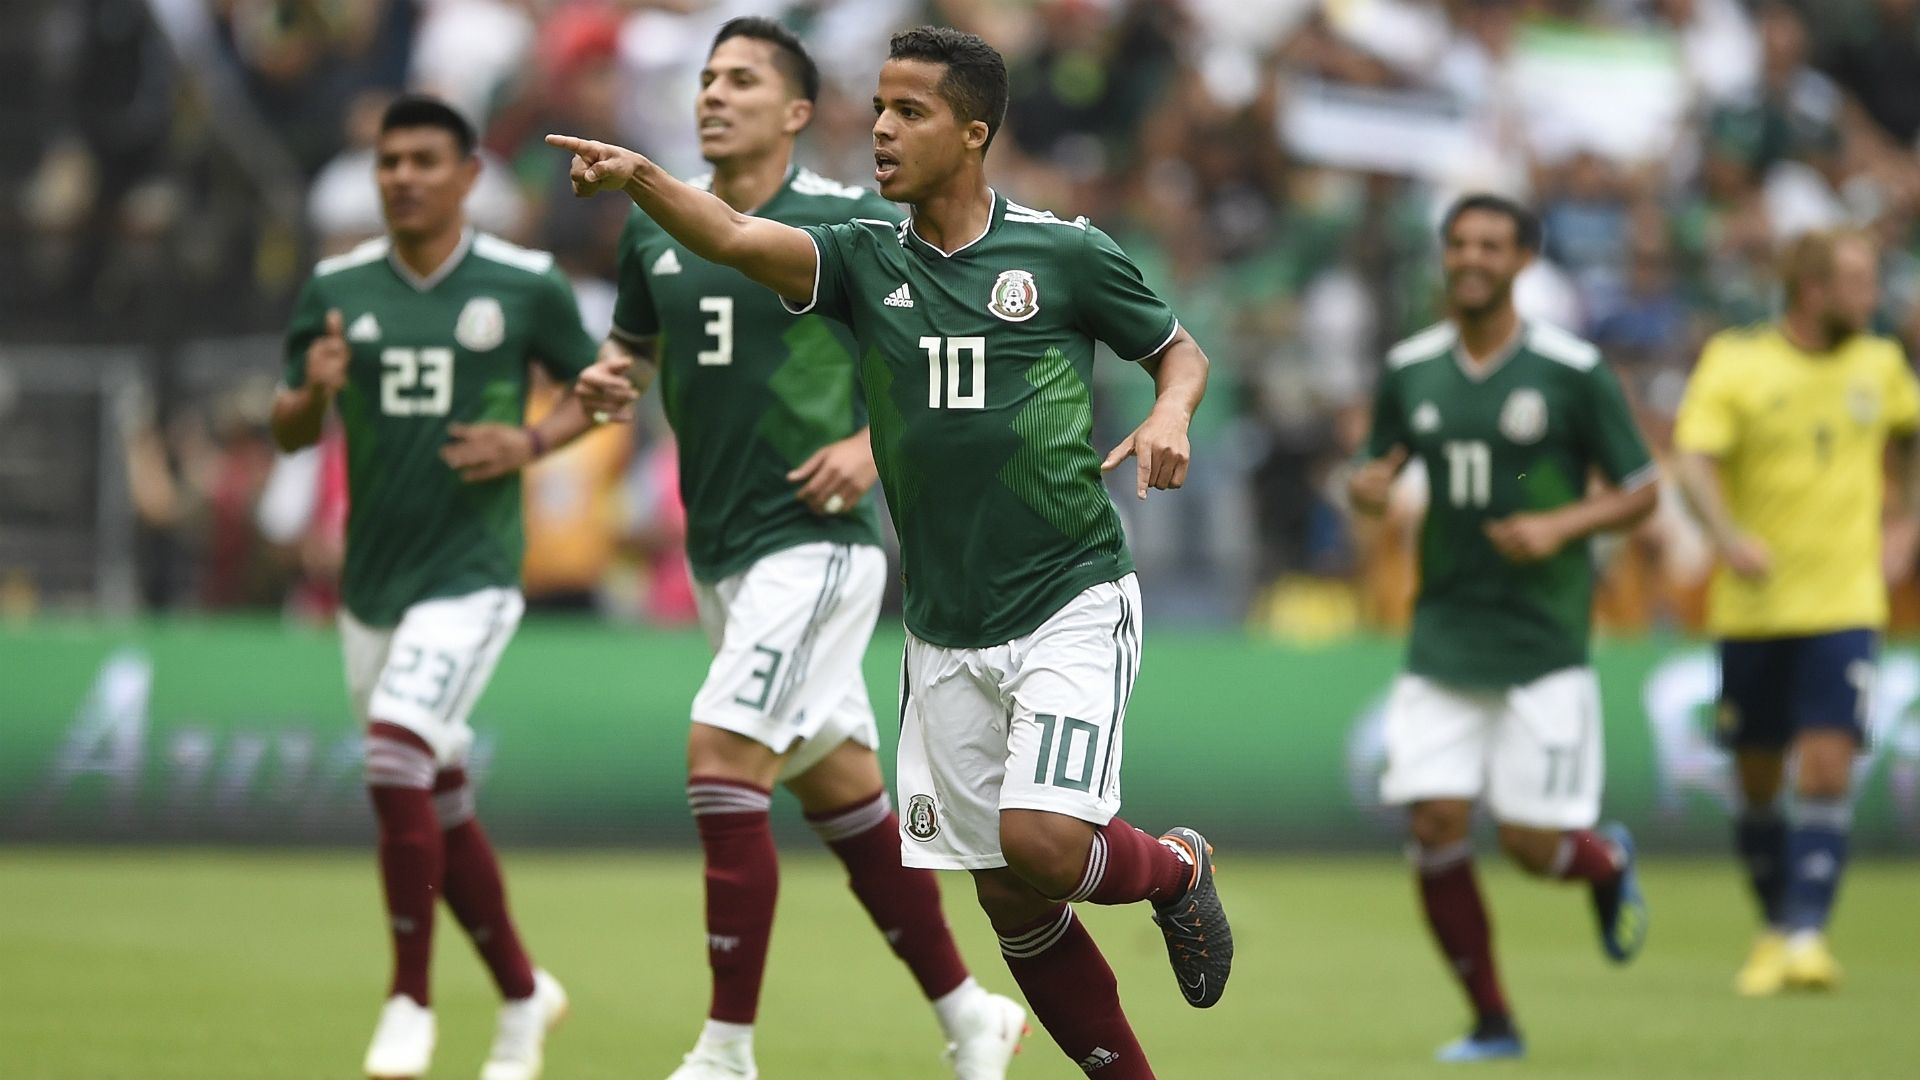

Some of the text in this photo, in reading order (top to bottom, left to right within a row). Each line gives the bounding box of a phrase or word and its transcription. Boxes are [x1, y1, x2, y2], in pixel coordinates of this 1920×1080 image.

[698, 296, 733, 366] 3
[883, 297, 913, 308] adidas
[381, 347, 454, 416] 23
[919, 336, 985, 409] 10
[1442, 440, 1491, 508] 11
[384, 645, 457, 710] 23
[735, 645, 782, 711] 3
[1034, 713, 1099, 793] 10
